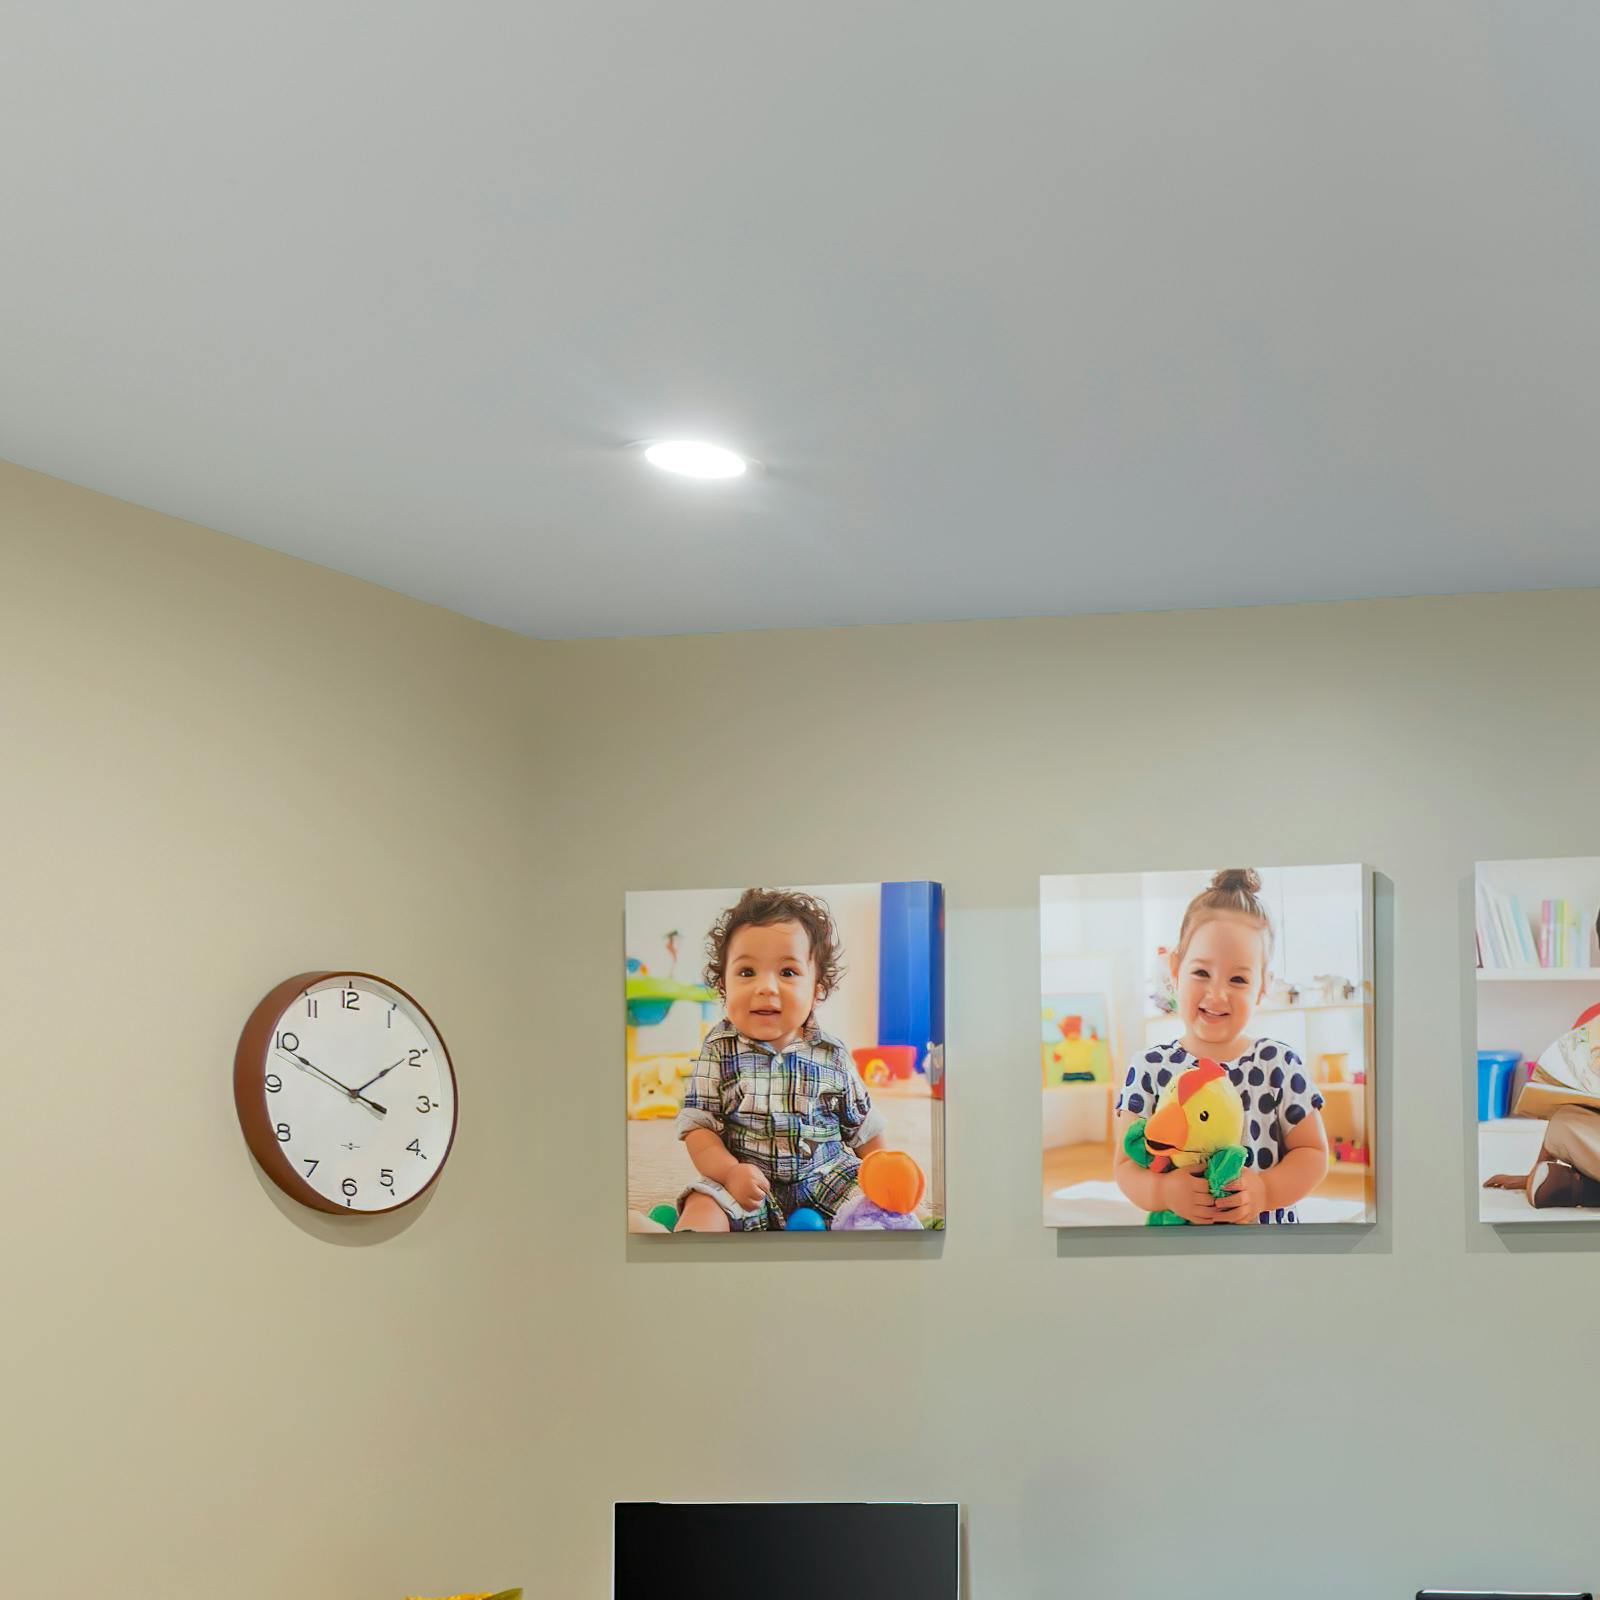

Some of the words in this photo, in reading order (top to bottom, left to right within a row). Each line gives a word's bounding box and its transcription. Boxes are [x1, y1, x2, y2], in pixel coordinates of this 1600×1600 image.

[307, 998, 318, 1019] 11
[341, 990, 360, 1011] 12
[386, 1010, 392, 1029] 1
[276, 1030, 299, 1052] 10
[408, 1049, 422, 1068] 2
[265, 1074, 283, 1093] 9
[416, 1095, 431, 1114] 3
[276, 1123, 291, 1143] 8
[405, 1138, 422, 1156] 4
[303, 1159, 320, 1178] 7
[380, 1168, 394, 1187] 5
[342, 1178, 358, 1197] 6
